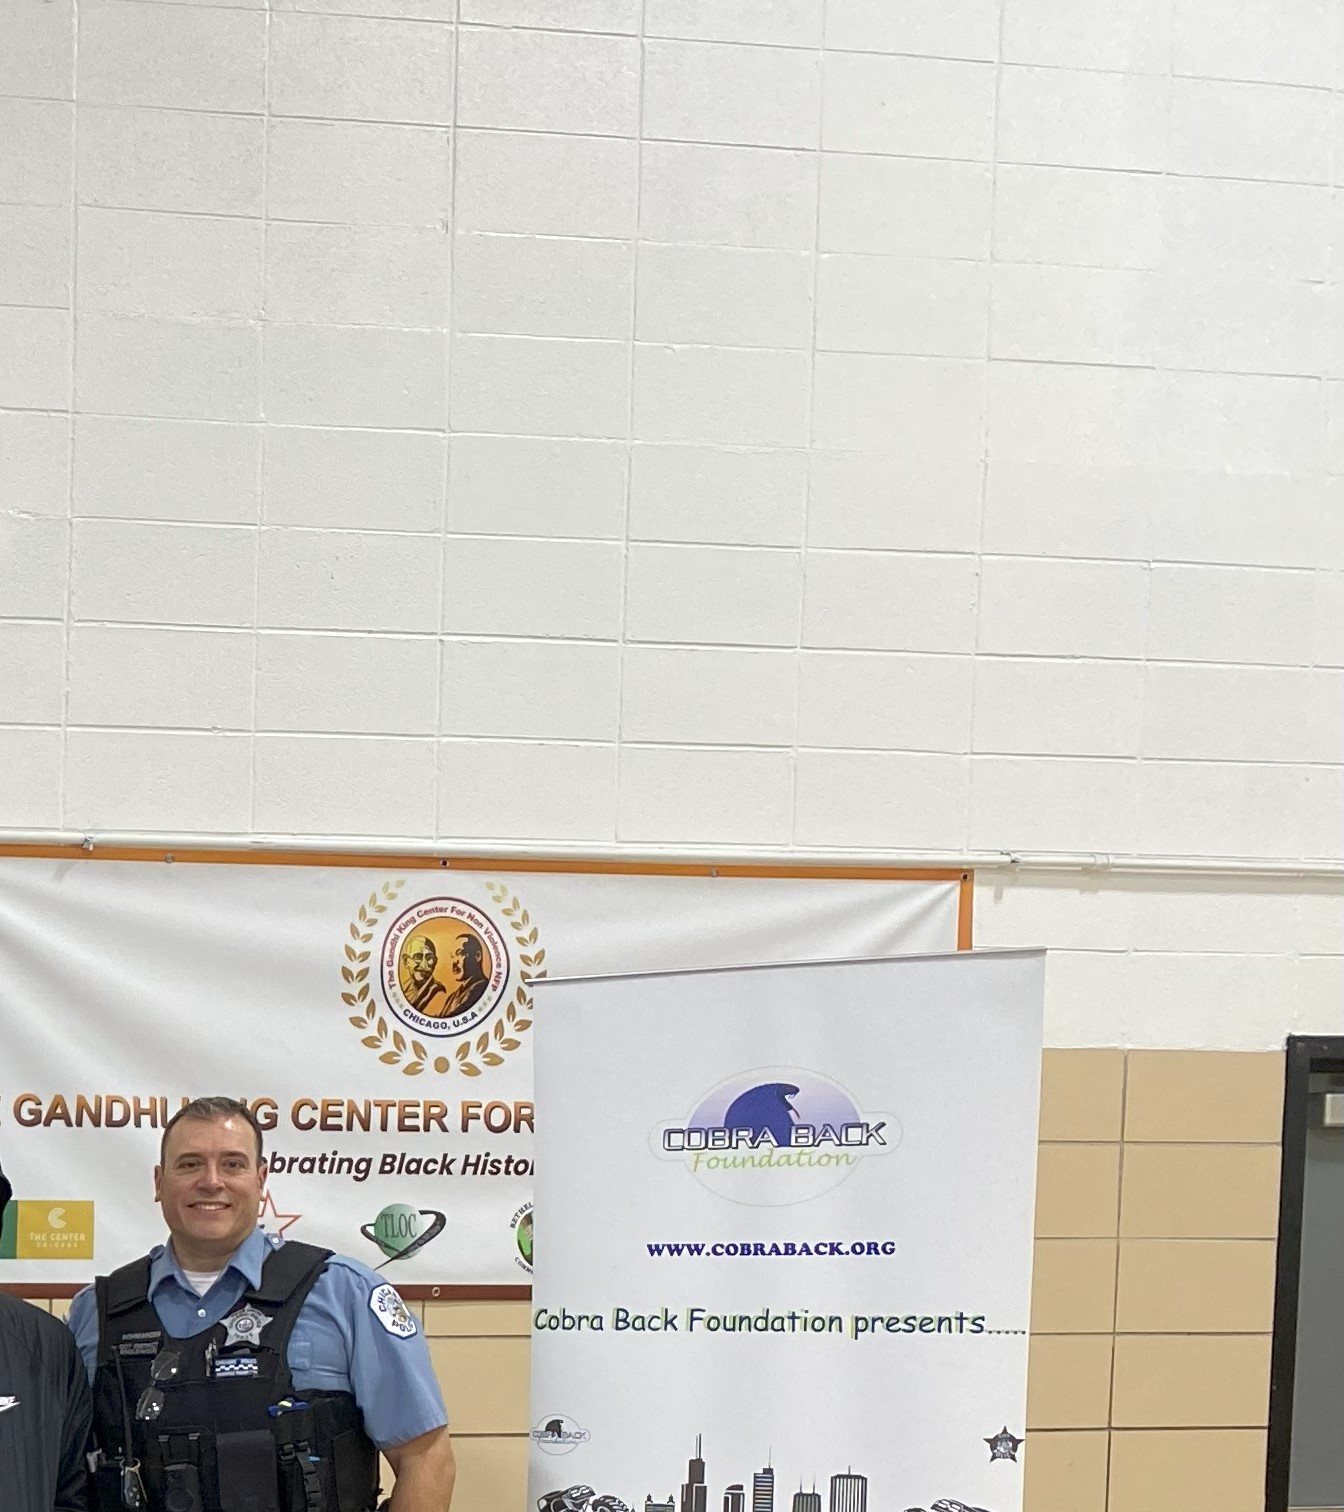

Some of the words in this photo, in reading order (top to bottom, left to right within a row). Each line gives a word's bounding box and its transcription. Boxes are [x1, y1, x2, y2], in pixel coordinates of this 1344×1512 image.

[416, 906, 449, 919] Center
[450, 906, 466, 917] For
[466, 912, 484, 929] Non
[402, 1008, 451, 1031] CHICAGO,
[290, 1097, 449, 1133] CENTER
[460, 1099, 535, 1134] FOR
[661, 1123, 779, 1153] COBRA
[788, 1119, 889, 1148] BACK
[262, 1150, 373, 1182] brating
[378, 1152, 457, 1176] Black
[460, 1151, 534, 1176] Histo
[690, 1148, 859, 1174] Foundation
[380, 1212, 418, 1239] TLOC
[645, 1241, 897, 1258] WWW.COBRABACK.ORG
[533, 1307, 605, 1334] Cobra
[613, 1307, 679, 1334] Back
[687, 1307, 844, 1335] Foundation
